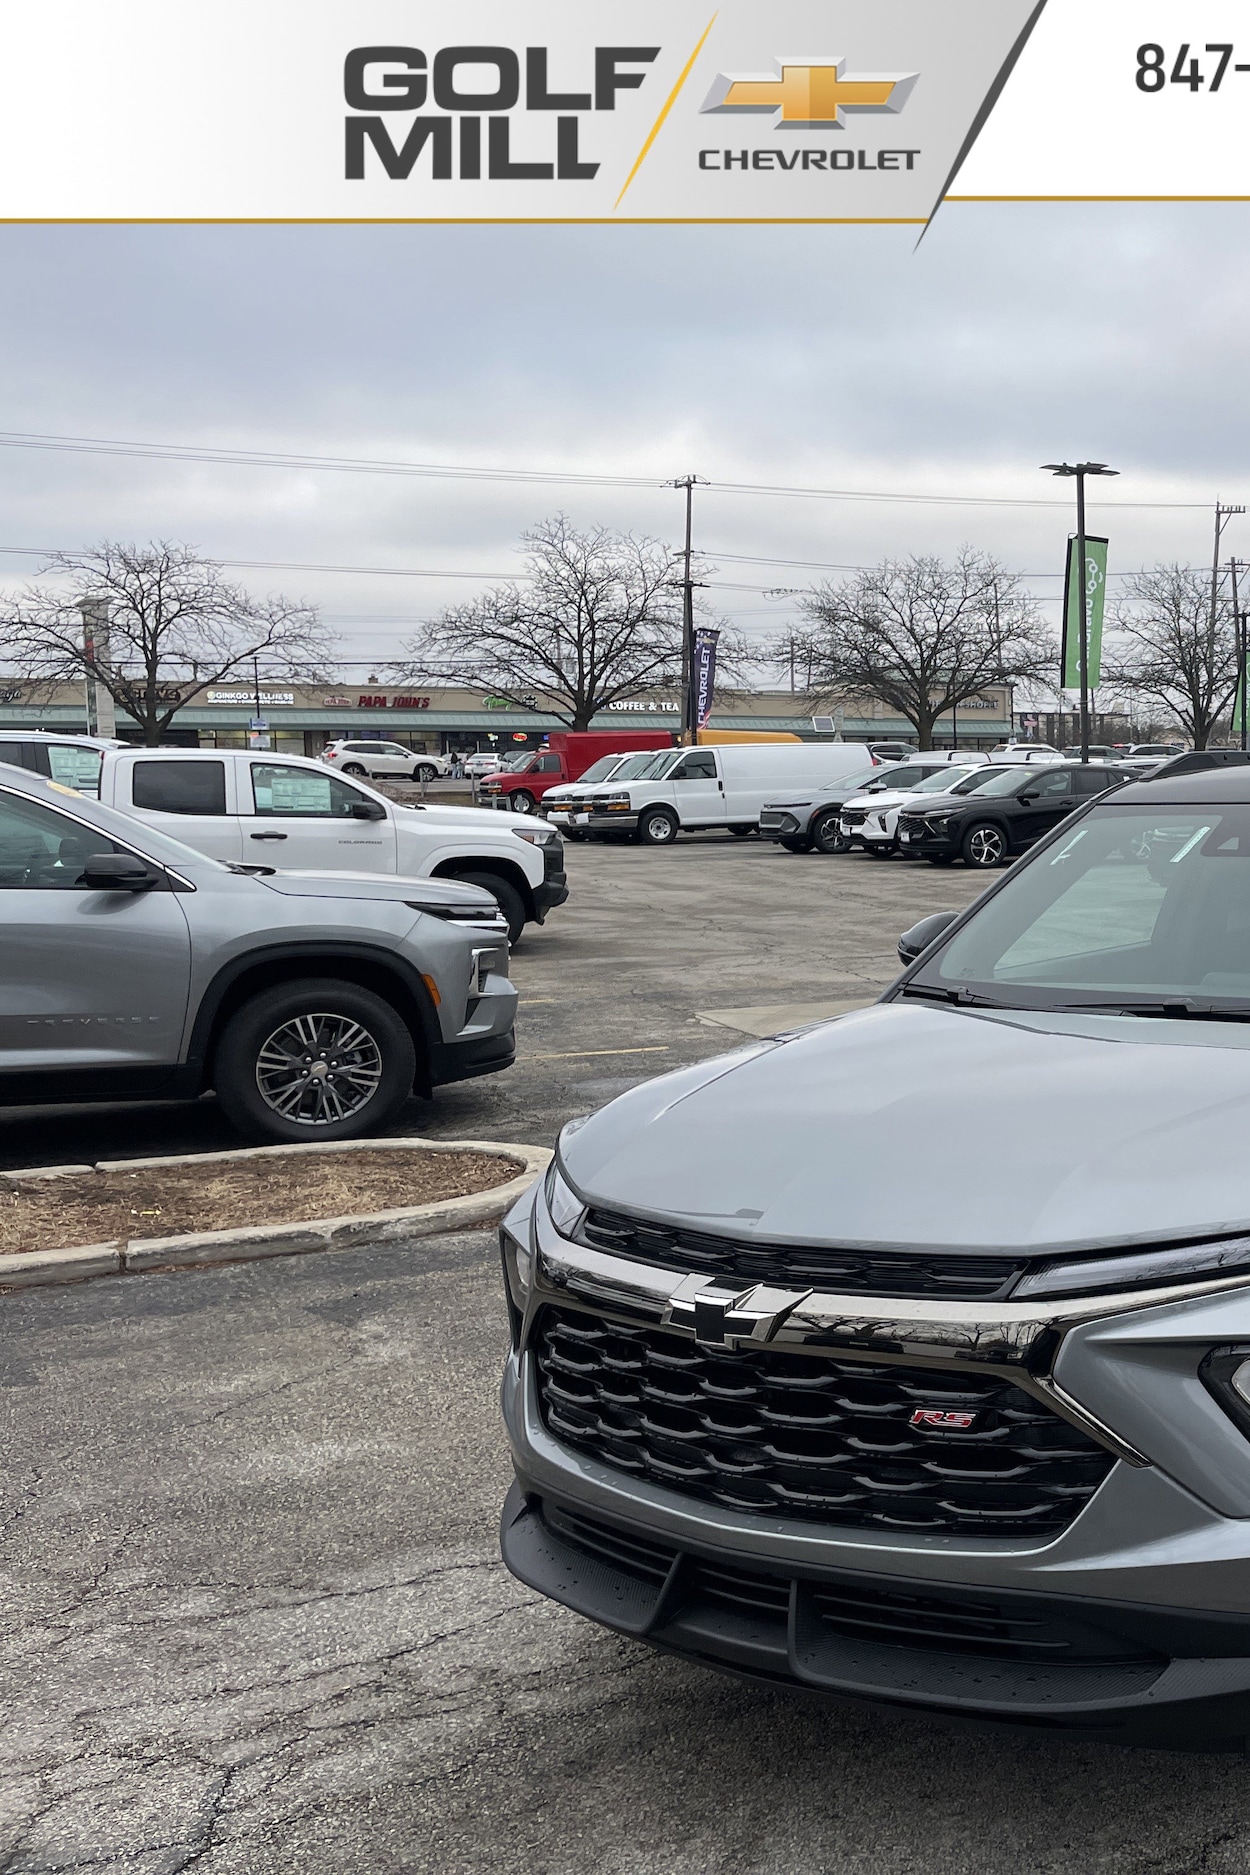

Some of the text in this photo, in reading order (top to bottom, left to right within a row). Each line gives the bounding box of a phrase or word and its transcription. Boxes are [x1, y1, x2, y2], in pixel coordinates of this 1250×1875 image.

[697, 646, 711, 724] CHEVROLET
[358, 696, 387, 708] PAPA
[389, 696, 430, 709] JOHN'S
[609, 702, 680, 711] COFFEE & TEA
[909, 1409, 977, 1428] RS
